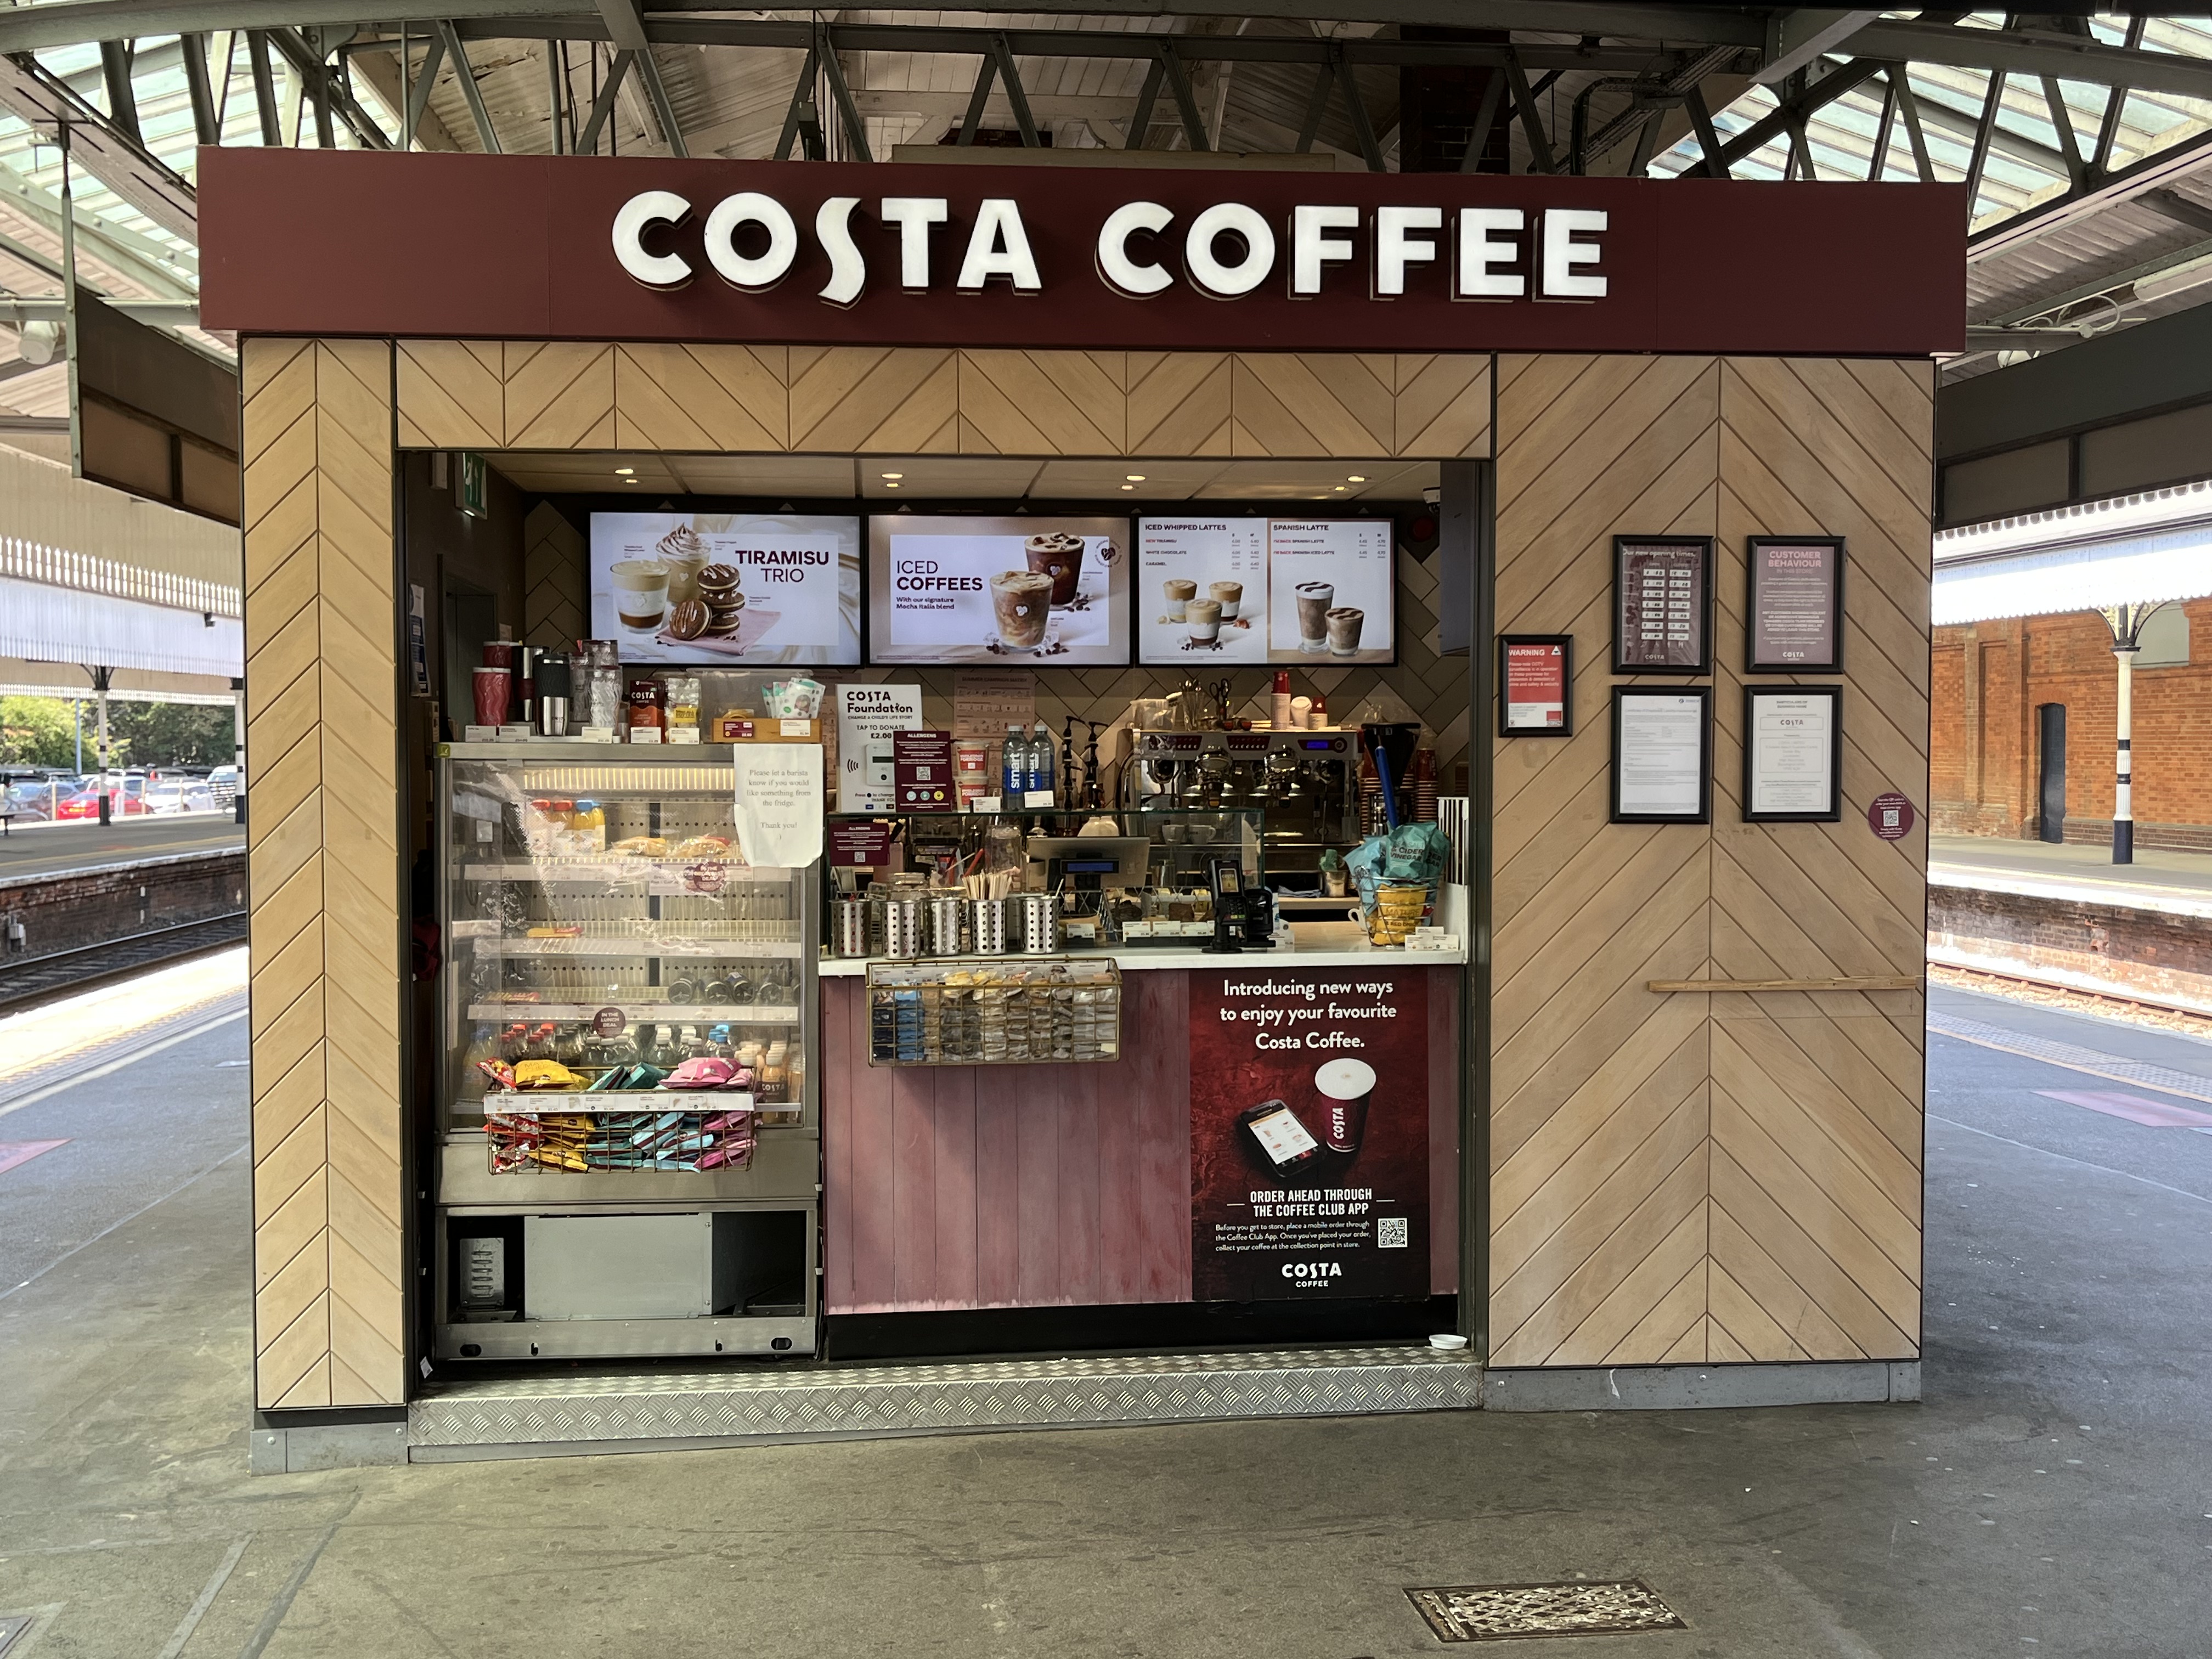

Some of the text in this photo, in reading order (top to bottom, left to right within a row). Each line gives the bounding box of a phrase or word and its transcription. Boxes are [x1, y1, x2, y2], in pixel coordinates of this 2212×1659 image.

[612, 190, 1608, 305] COSTA COFFEE
[735, 550, 829, 565] TIRAMISU
[1649, 551, 1675, 559] opening
[1769, 551, 1821, 559] CUSTOMER
[897, 561, 938, 574] ICED
[1768, 559, 1821, 567] BEHAVIOUR
[760, 568, 804, 583] TRIO
[897, 577, 983, 591] COFFEES
[847, 691, 891, 702] COSTA
[847, 703, 913, 713] Foundation
[1009, 753, 1020, 789] smart
[1390, 853, 1423, 861] VINEGAR
[1224, 979, 1393, 1001] Introducing new ways
[1220, 1002, 1397, 1026] to enjoy your favourite
[1255, 1031, 1365, 1049] Costa Coffee.
[1332, 1107, 1345, 1139] COSTA
[1250, 1188, 1372, 1203] ORDER AHEAD THROUGH
[1253, 1203, 1369, 1217] THE COFFEE CLUB APP
[1286, 1223, 1302, 1231] place
[1346, 1221, 1370, 1229] through
[1318, 1232, 1338, 1240] placed
[1319, 1242, 1335, 1250] point
[1282, 1262, 1342, 1279] COSTA
